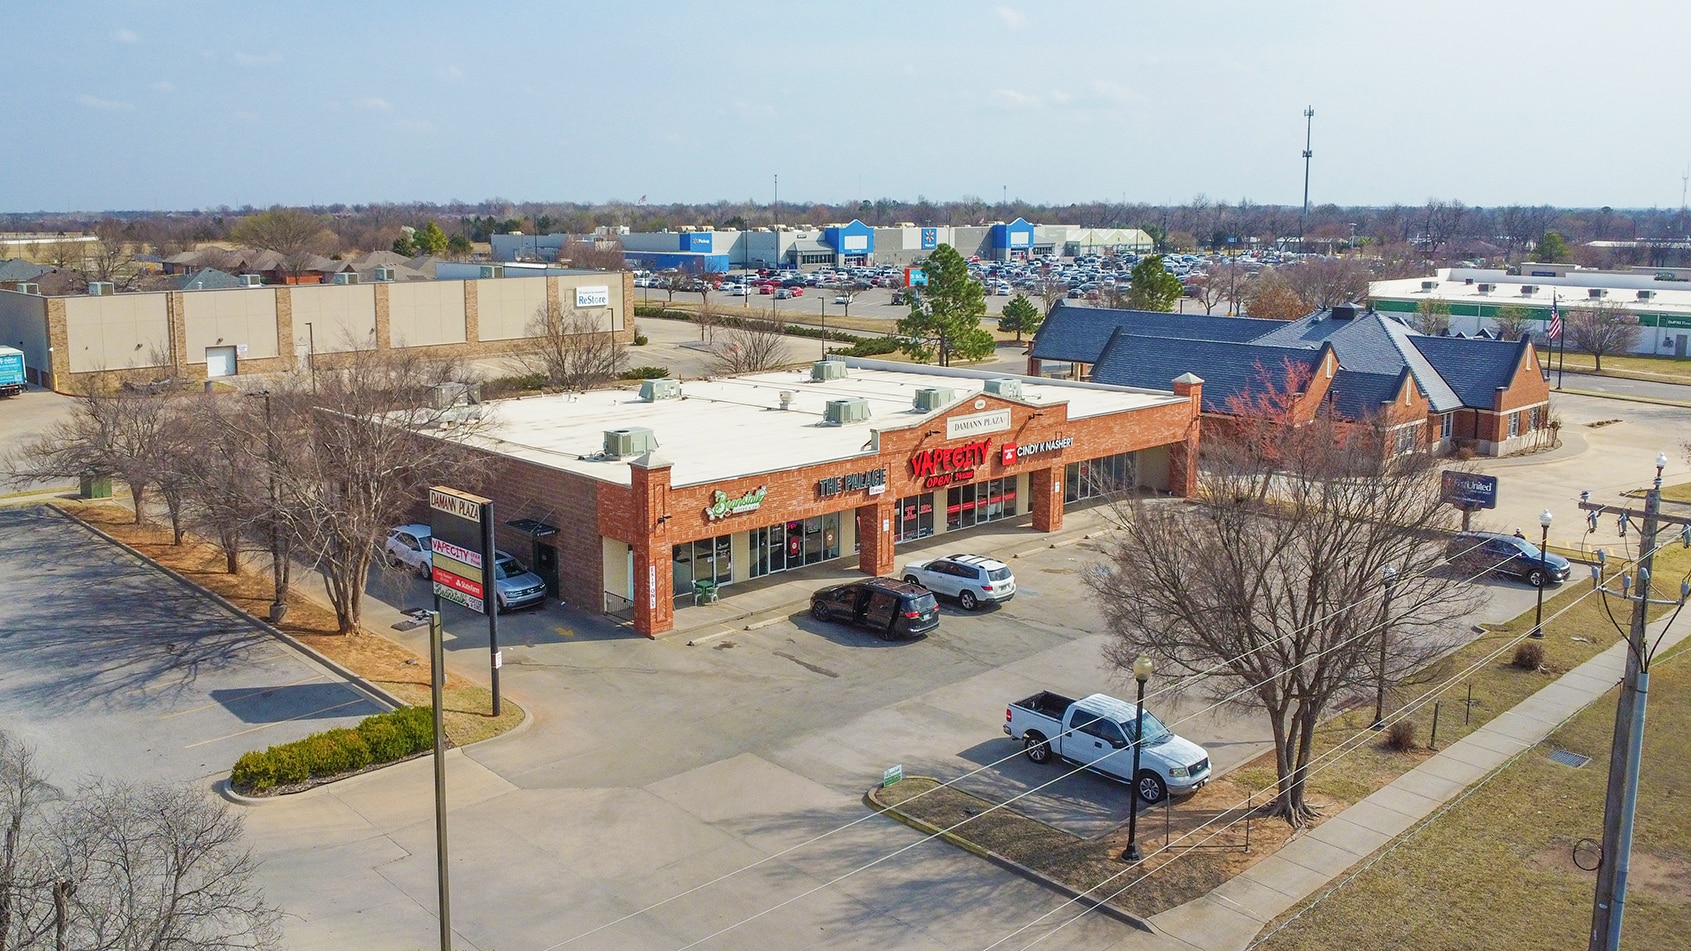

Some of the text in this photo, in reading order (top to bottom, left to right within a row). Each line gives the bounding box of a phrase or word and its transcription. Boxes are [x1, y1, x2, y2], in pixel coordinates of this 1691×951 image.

[578, 295, 607, 305] ReStore
[954, 416, 1004, 431] DAMANN PLAZA
[911, 438, 992, 477] VAPECITY
[1016, 437, 1074, 457] CINDY K NASHERT
[820, 468, 887, 497] THE PALACE
[926, 474, 952, 489] OPEN
[431, 491, 479, 520] DAMANN PLAZA
[713, 489, 766, 516] Beanstalk
[432, 540, 469, 562] VAPECITY
